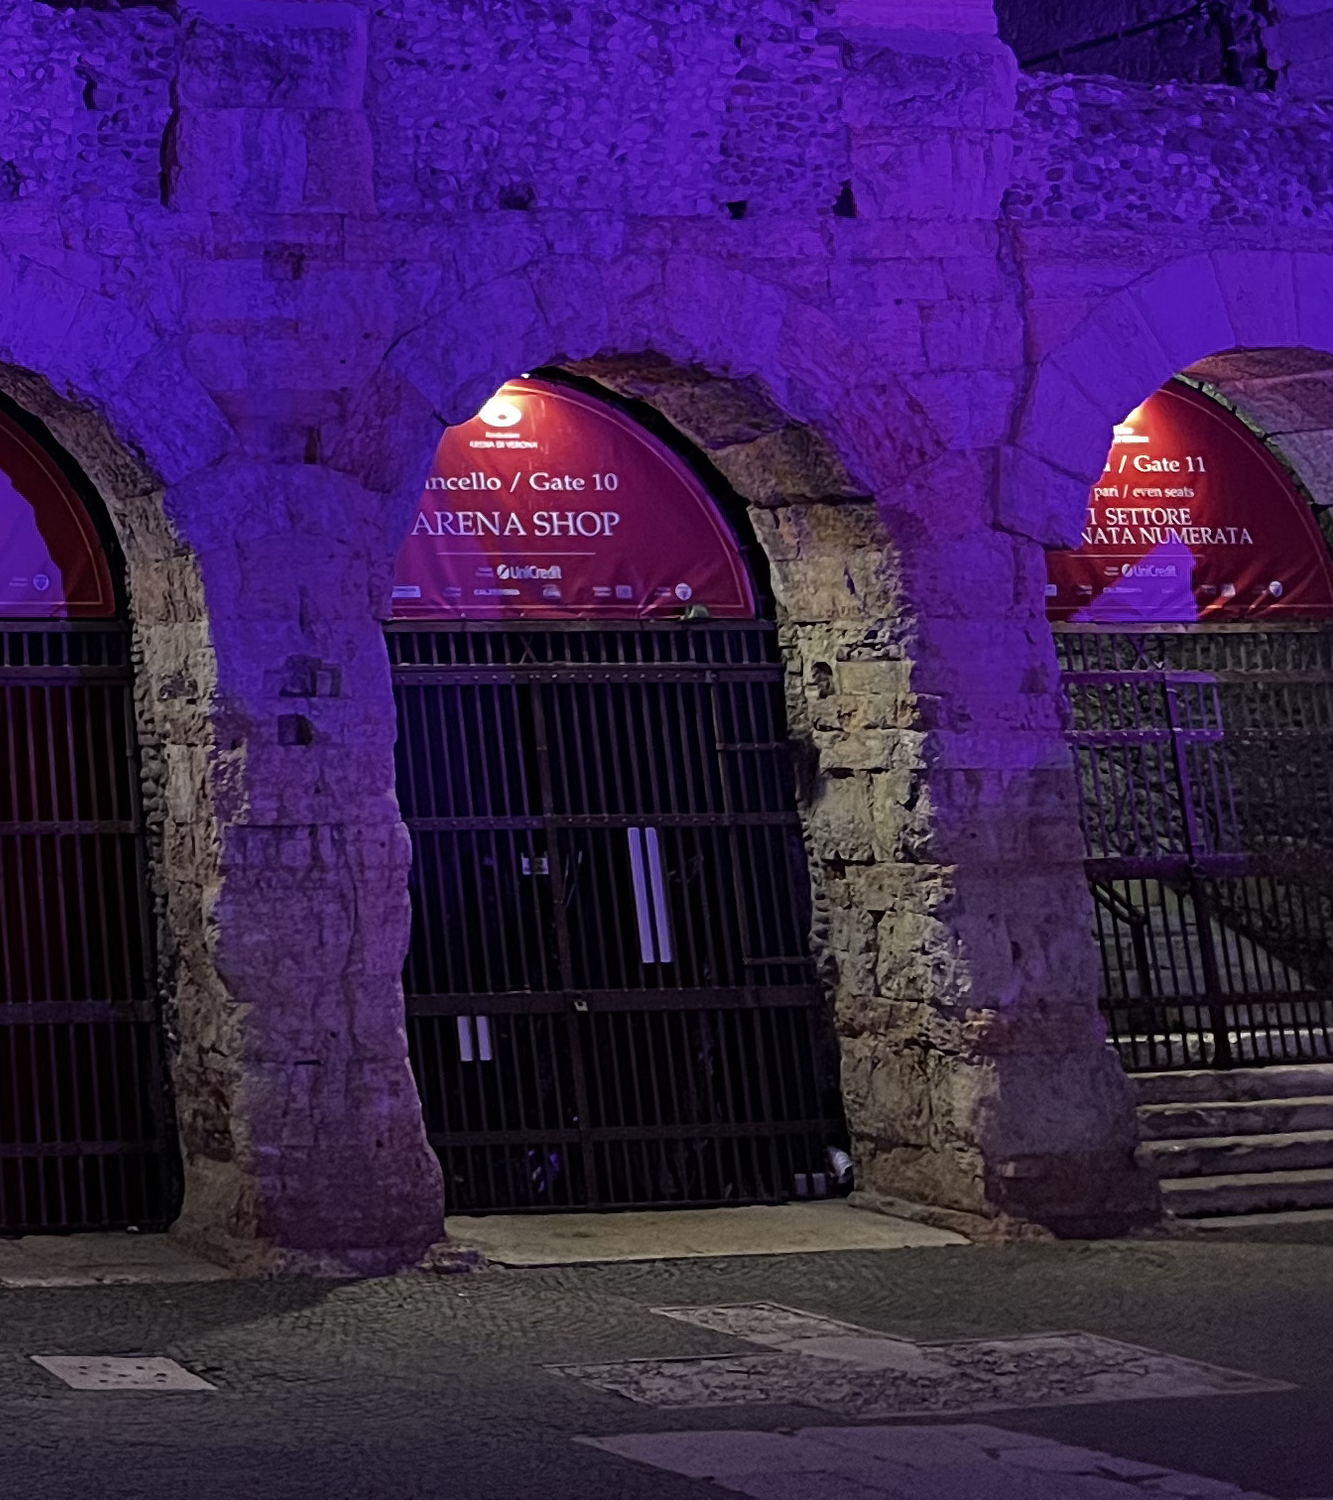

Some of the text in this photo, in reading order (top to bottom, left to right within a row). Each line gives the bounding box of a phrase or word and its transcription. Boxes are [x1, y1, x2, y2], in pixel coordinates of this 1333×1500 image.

[1133, 455, 1180, 472] Gate
[1186, 456, 1206, 473] 11
[529, 472, 585, 491] Gate
[592, 473, 619, 491] 10
[1094, 485, 1119, 501] pari
[1133, 486, 1163, 498] even
[1164, 485, 1195, 498] seats
[411, 511, 621, 537] ARENA SHOP
[1105, 507, 1192, 526] SETTORE
[1139, 527, 1253, 545] NUMERATA
